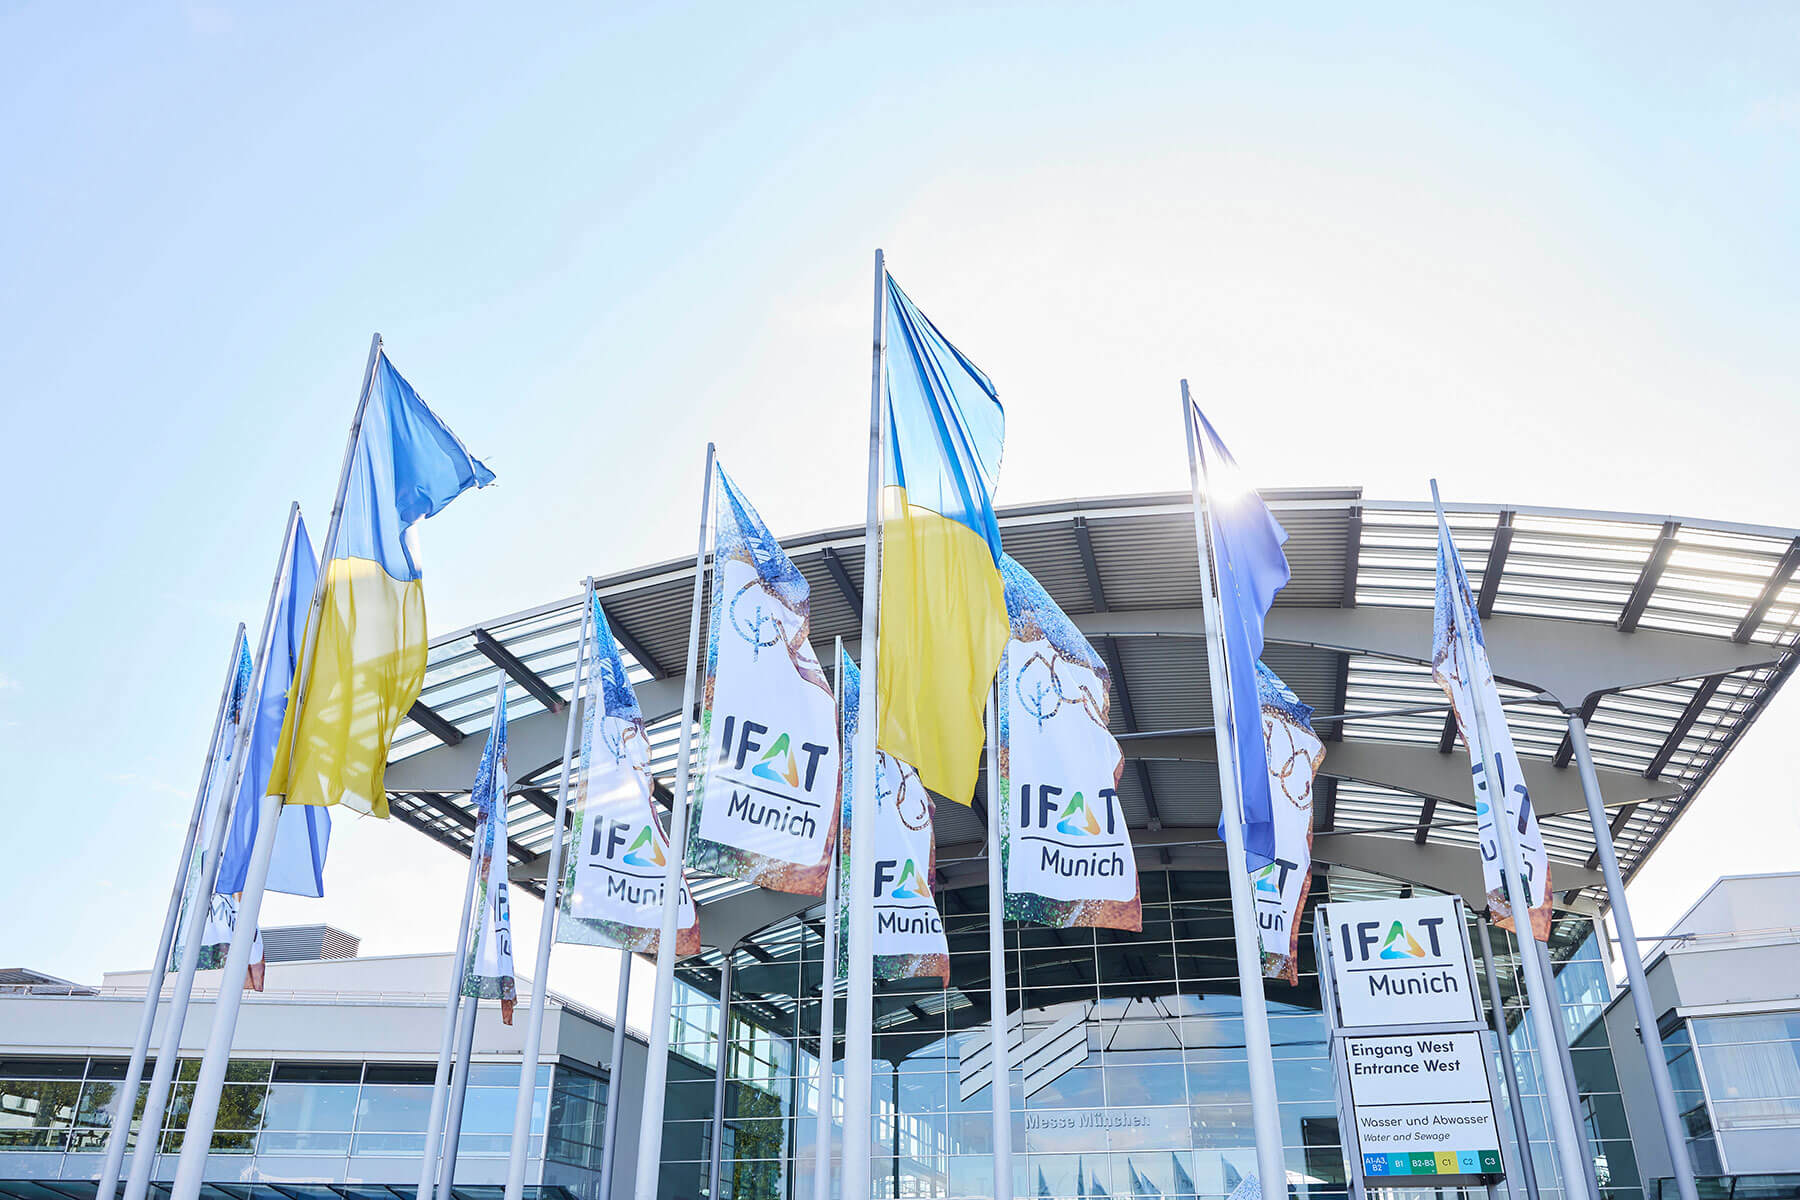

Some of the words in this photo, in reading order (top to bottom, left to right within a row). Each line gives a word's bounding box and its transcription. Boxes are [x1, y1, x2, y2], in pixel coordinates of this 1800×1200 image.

[718, 715, 829, 792] IFAT
[727, 789, 817, 839] Munich
[1020, 784, 1117, 836] IFAT
[1041, 845, 1124, 877] Munich
[607, 874, 688, 906] Munih
[878, 911, 942, 934] Munic
[1340, 917, 1445, 962] IFAT
[1368, 971, 1459, 997] Munich
[1351, 1043, 1413, 1058] Eingang
[1417, 1041, 1455, 1053] West
[1354, 1062, 1420, 1075] Entrance
[1424, 1059, 1461, 1072] West
[1026, 1112, 1076, 1130] Messe
[1079, 1111, 1151, 1128] München
[1361, 1117, 1402, 1127] Wasser
[1406, 1115, 1429, 1126] und
[1433, 1114, 1488, 1125] Abwasser
[1364, 1133, 1389, 1142] Water
[1393, 1132, 1411, 1141] and
[1414, 1131, 1450, 1142] Sewage
[1372, 1163, 1382, 1172] B2
[1395, 1159, 1404, 1168] B1
[1442, 1158, 1452, 1167] C1
[1463, 1157, 1474, 1166] C2
[1484, 1157, 1496, 1165] C3
